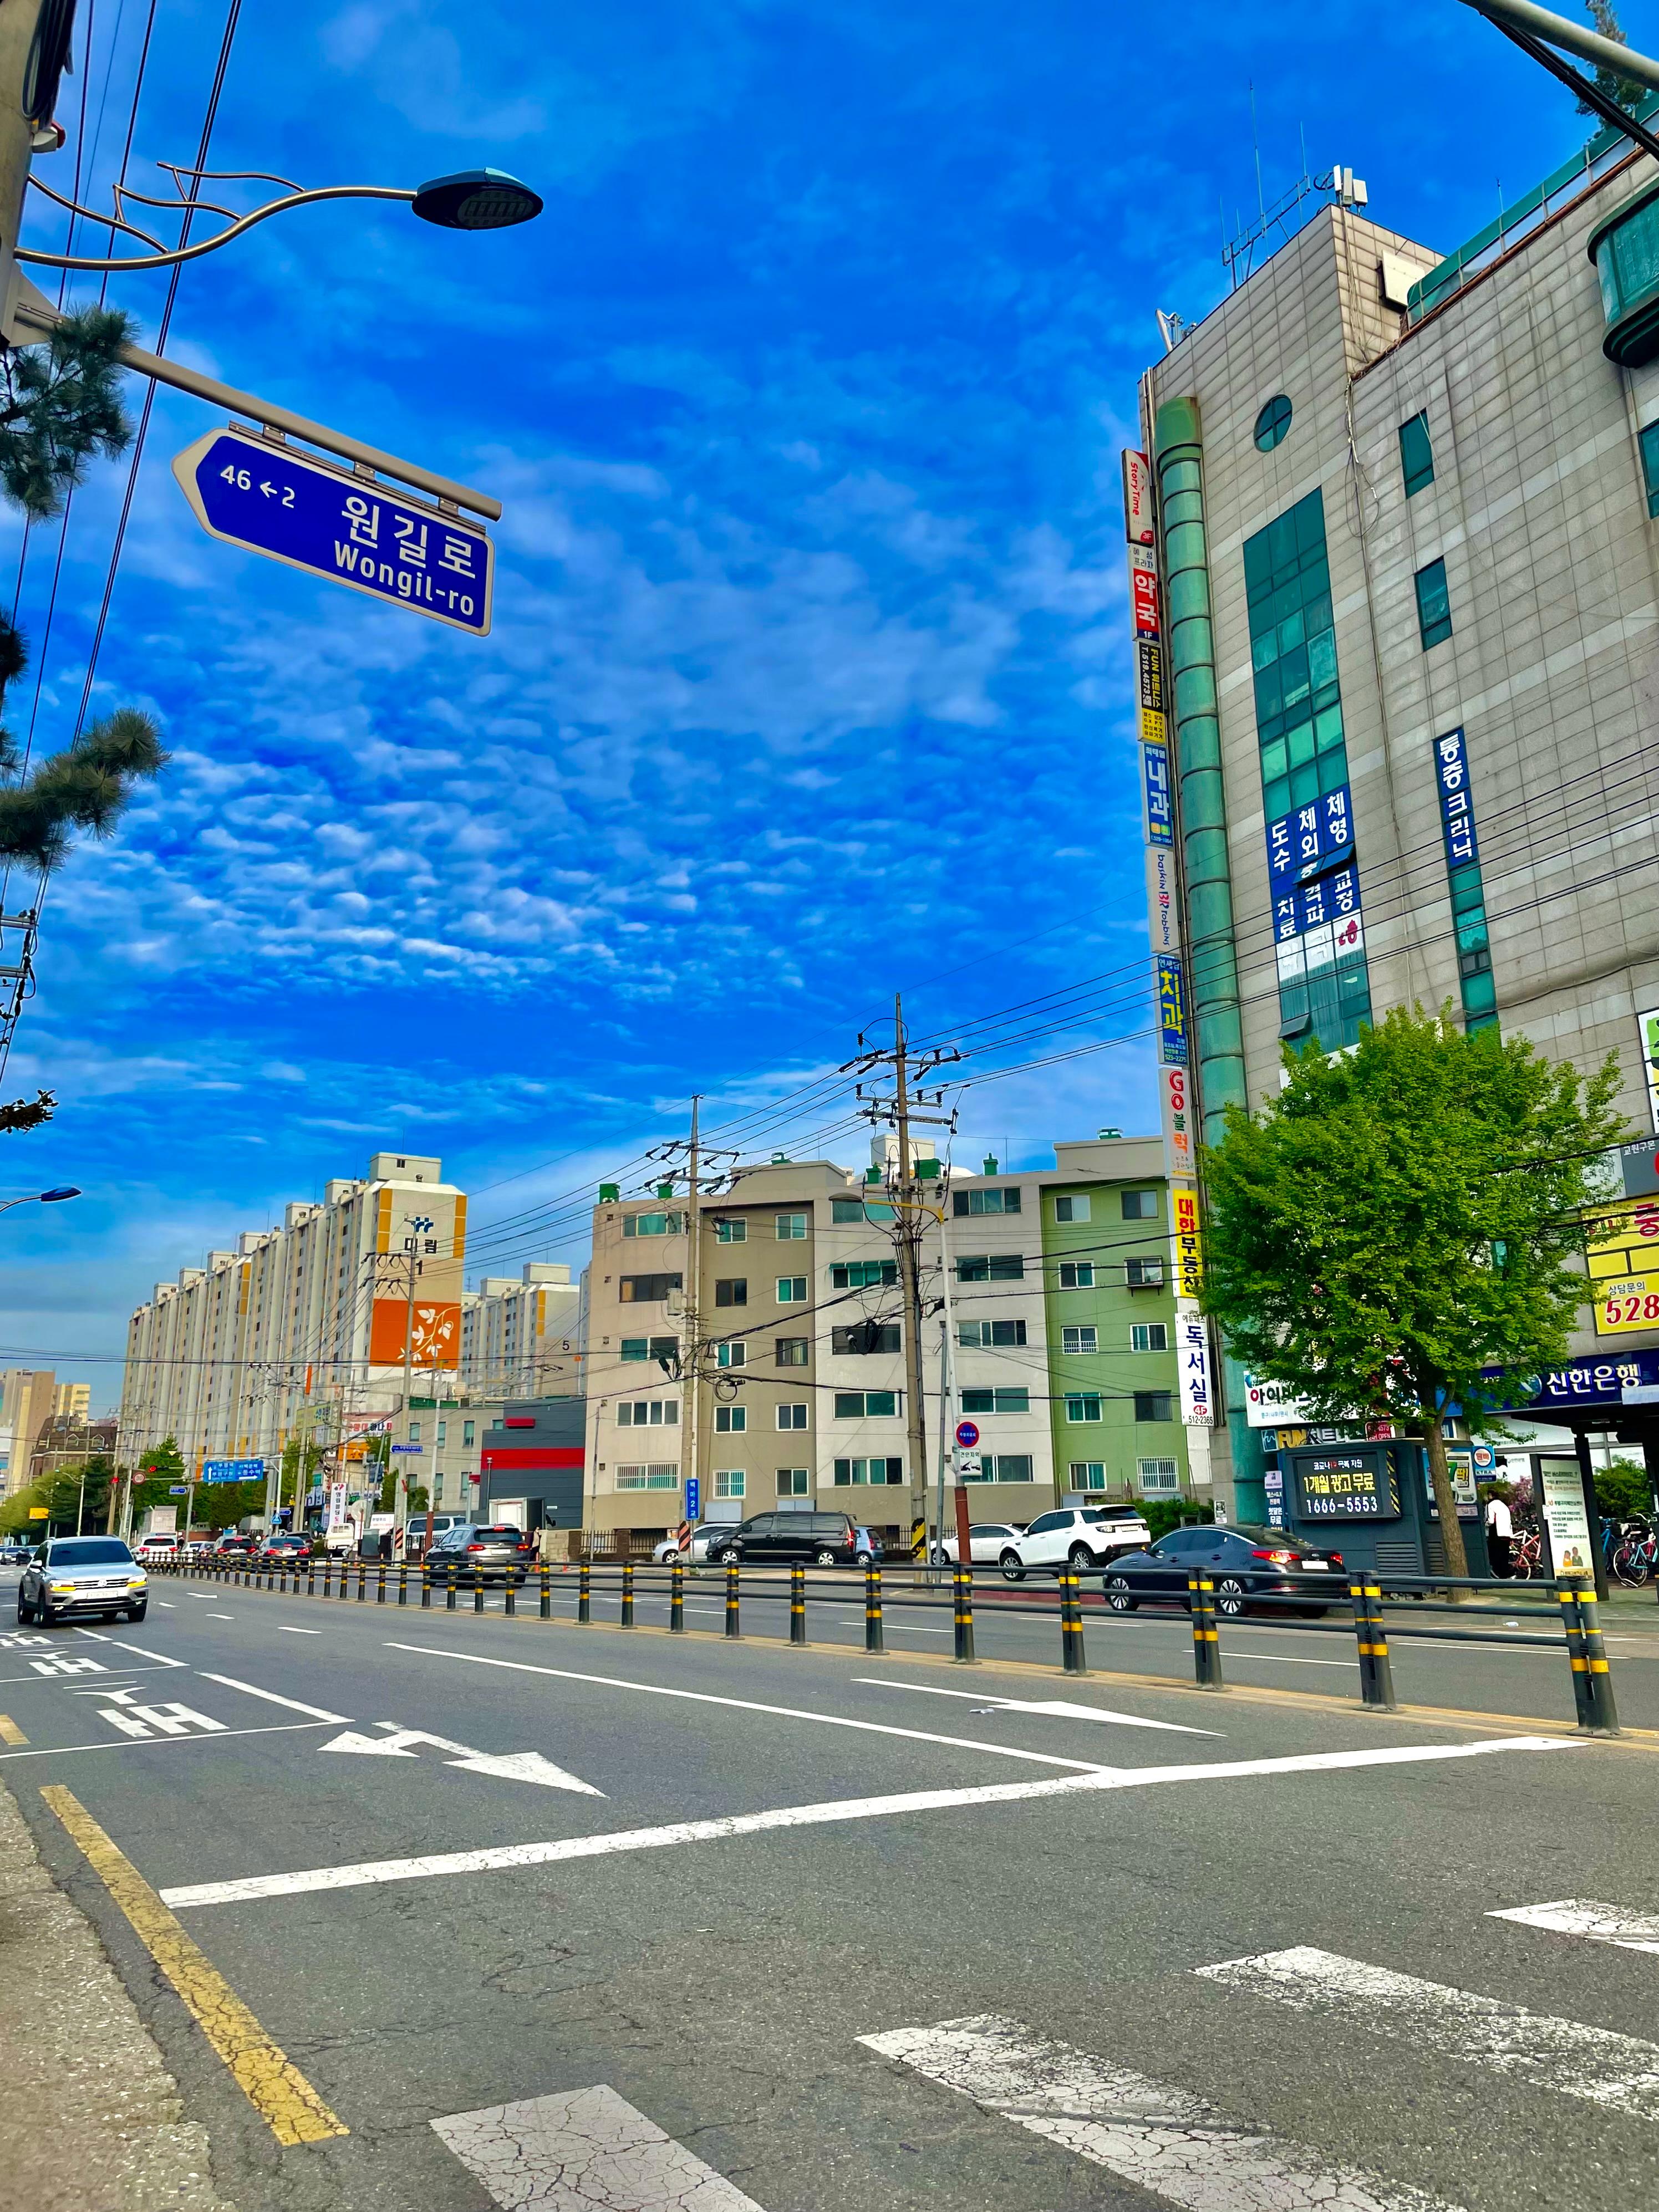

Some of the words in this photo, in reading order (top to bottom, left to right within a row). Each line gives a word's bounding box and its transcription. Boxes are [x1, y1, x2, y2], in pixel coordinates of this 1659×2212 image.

[220, 465, 251, 491] 46
[281, 487, 296, 509] 2
[341, 496, 476, 579] 원길로
[334, 540, 474, 616] Wongil-ro
[1135, 574, 1155, 627] 약국
[1151, 648, 1159, 671] FUN
[1148, 761, 1169, 822] 내과
[1299, 807, 1319, 858] 체외
[1327, 791, 1347, 844] 체형
[1272, 821, 1290, 871] 도수
[1335, 870, 1353, 912] 교정
[1161, 910, 1170, 946] robbins
[1278, 898, 1296, 940] 치료
[1160, 970, 1185, 1036] 치과
[1624, 1140, 1656, 1156] 교원구몬
[1609, 1281, 1645, 1296] 상담문의
[562, 1340, 570, 1350] 5
[1186, 1326, 1207, 1403] 독서실
[1546, 1363, 1642, 1395] 신한은행
[1188, 1415, 1213, 1425] 512-2365
[1304, 1475, 1330, 1494] 1개월
[1331, 1473, 1352, 1493] 광고
[1353, 1472, 1375, 1491] 무료
[1270, 1516, 1281, 1525] 무료
[1306, 1496, 1378, 1514] 1666-5553
